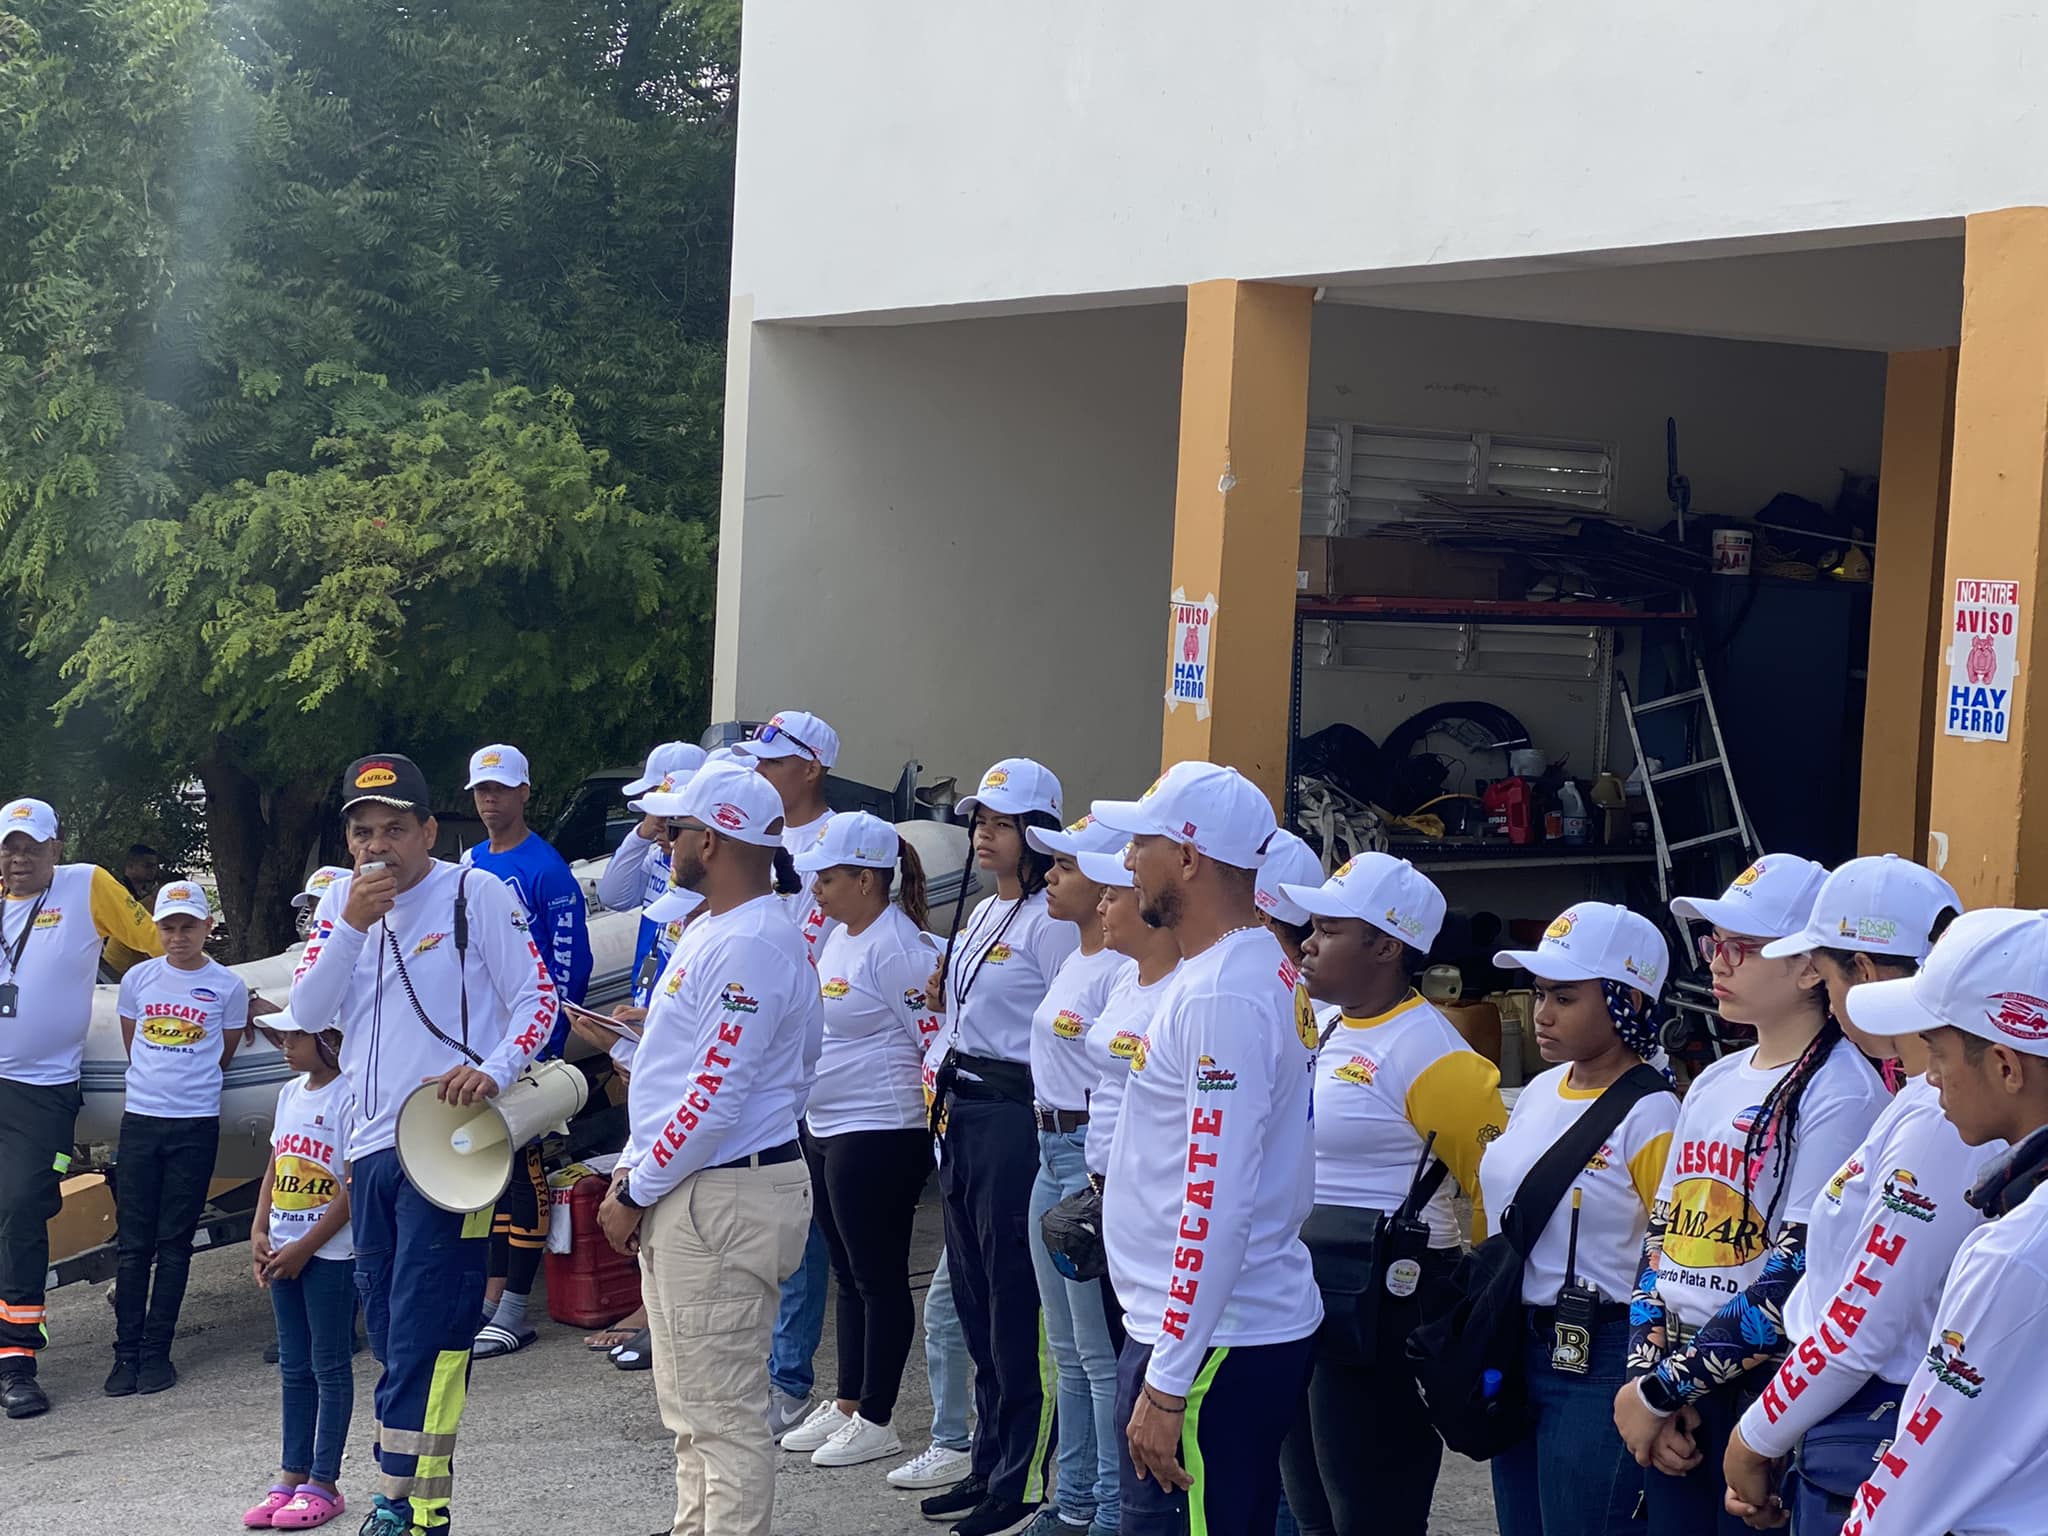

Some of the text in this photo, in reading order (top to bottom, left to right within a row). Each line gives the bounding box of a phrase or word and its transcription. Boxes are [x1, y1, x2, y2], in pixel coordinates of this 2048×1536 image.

[1960, 581, 2014, 605] NO ENTRE
[1178, 607, 1209, 626] AVISO
[1956, 609, 2013, 635] AVISO
[1175, 663, 1205, 680] HAY
[1174, 680, 1204, 699] PERRO
[1951, 685, 2007, 709] HAY
[1949, 707, 2005, 734] PERRO
[144, 1003, 209, 1024] RESCATE
[652, 1022, 743, 1169] RESCATE
[281, 1212, 304, 1222] Plata
[1163, 1107, 1223, 1341] RESCATE
[1679, 1270, 1707, 1288] Plata
[1709, 1274, 1743, 1295] R.D.
[1762, 1223, 1907, 1424] RESCATE
